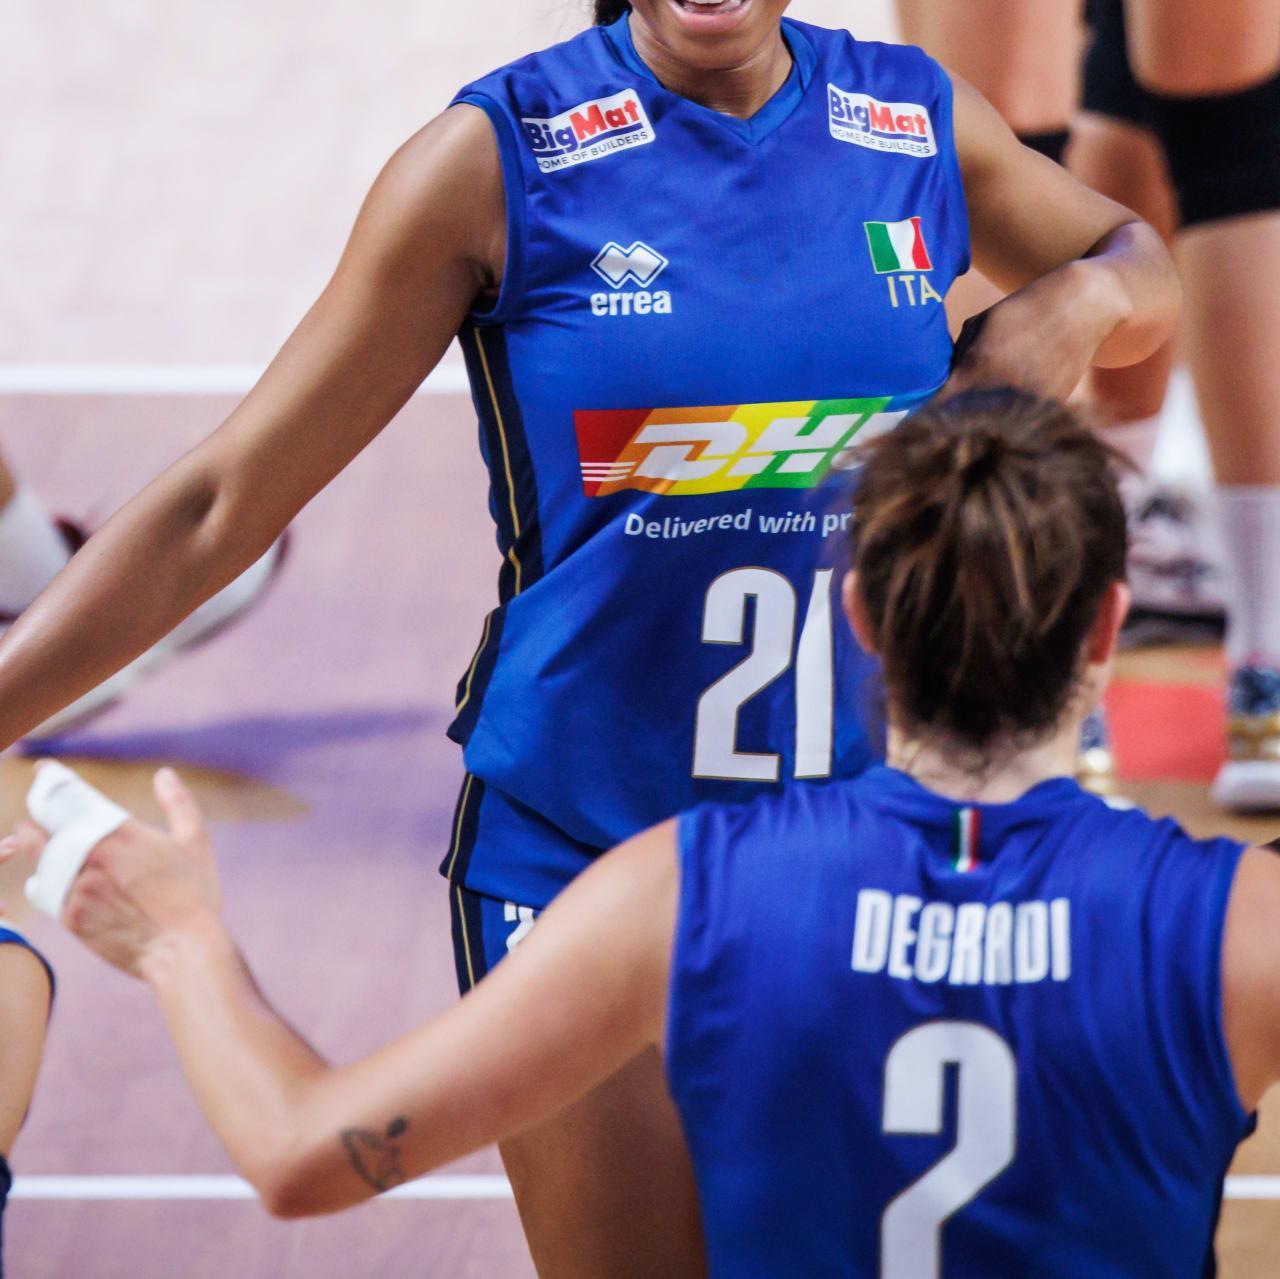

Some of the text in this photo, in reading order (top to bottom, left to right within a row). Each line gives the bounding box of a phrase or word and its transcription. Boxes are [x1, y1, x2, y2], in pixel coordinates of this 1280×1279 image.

[523, 99, 640, 154] BigMat
[830, 87, 927, 136] BigMat
[572, 150, 589, 162] OF
[590, 131, 649, 156] BUILDERS
[832, 128, 931, 154] HOME OF BUILDERS
[887, 275, 943, 308] ITA
[625, 508, 752, 540] Delivered
[759, 511, 816, 534] with
[852, 888, 1070, 985] DEGRADI
[880, 1019, 1016, 1277] 2
